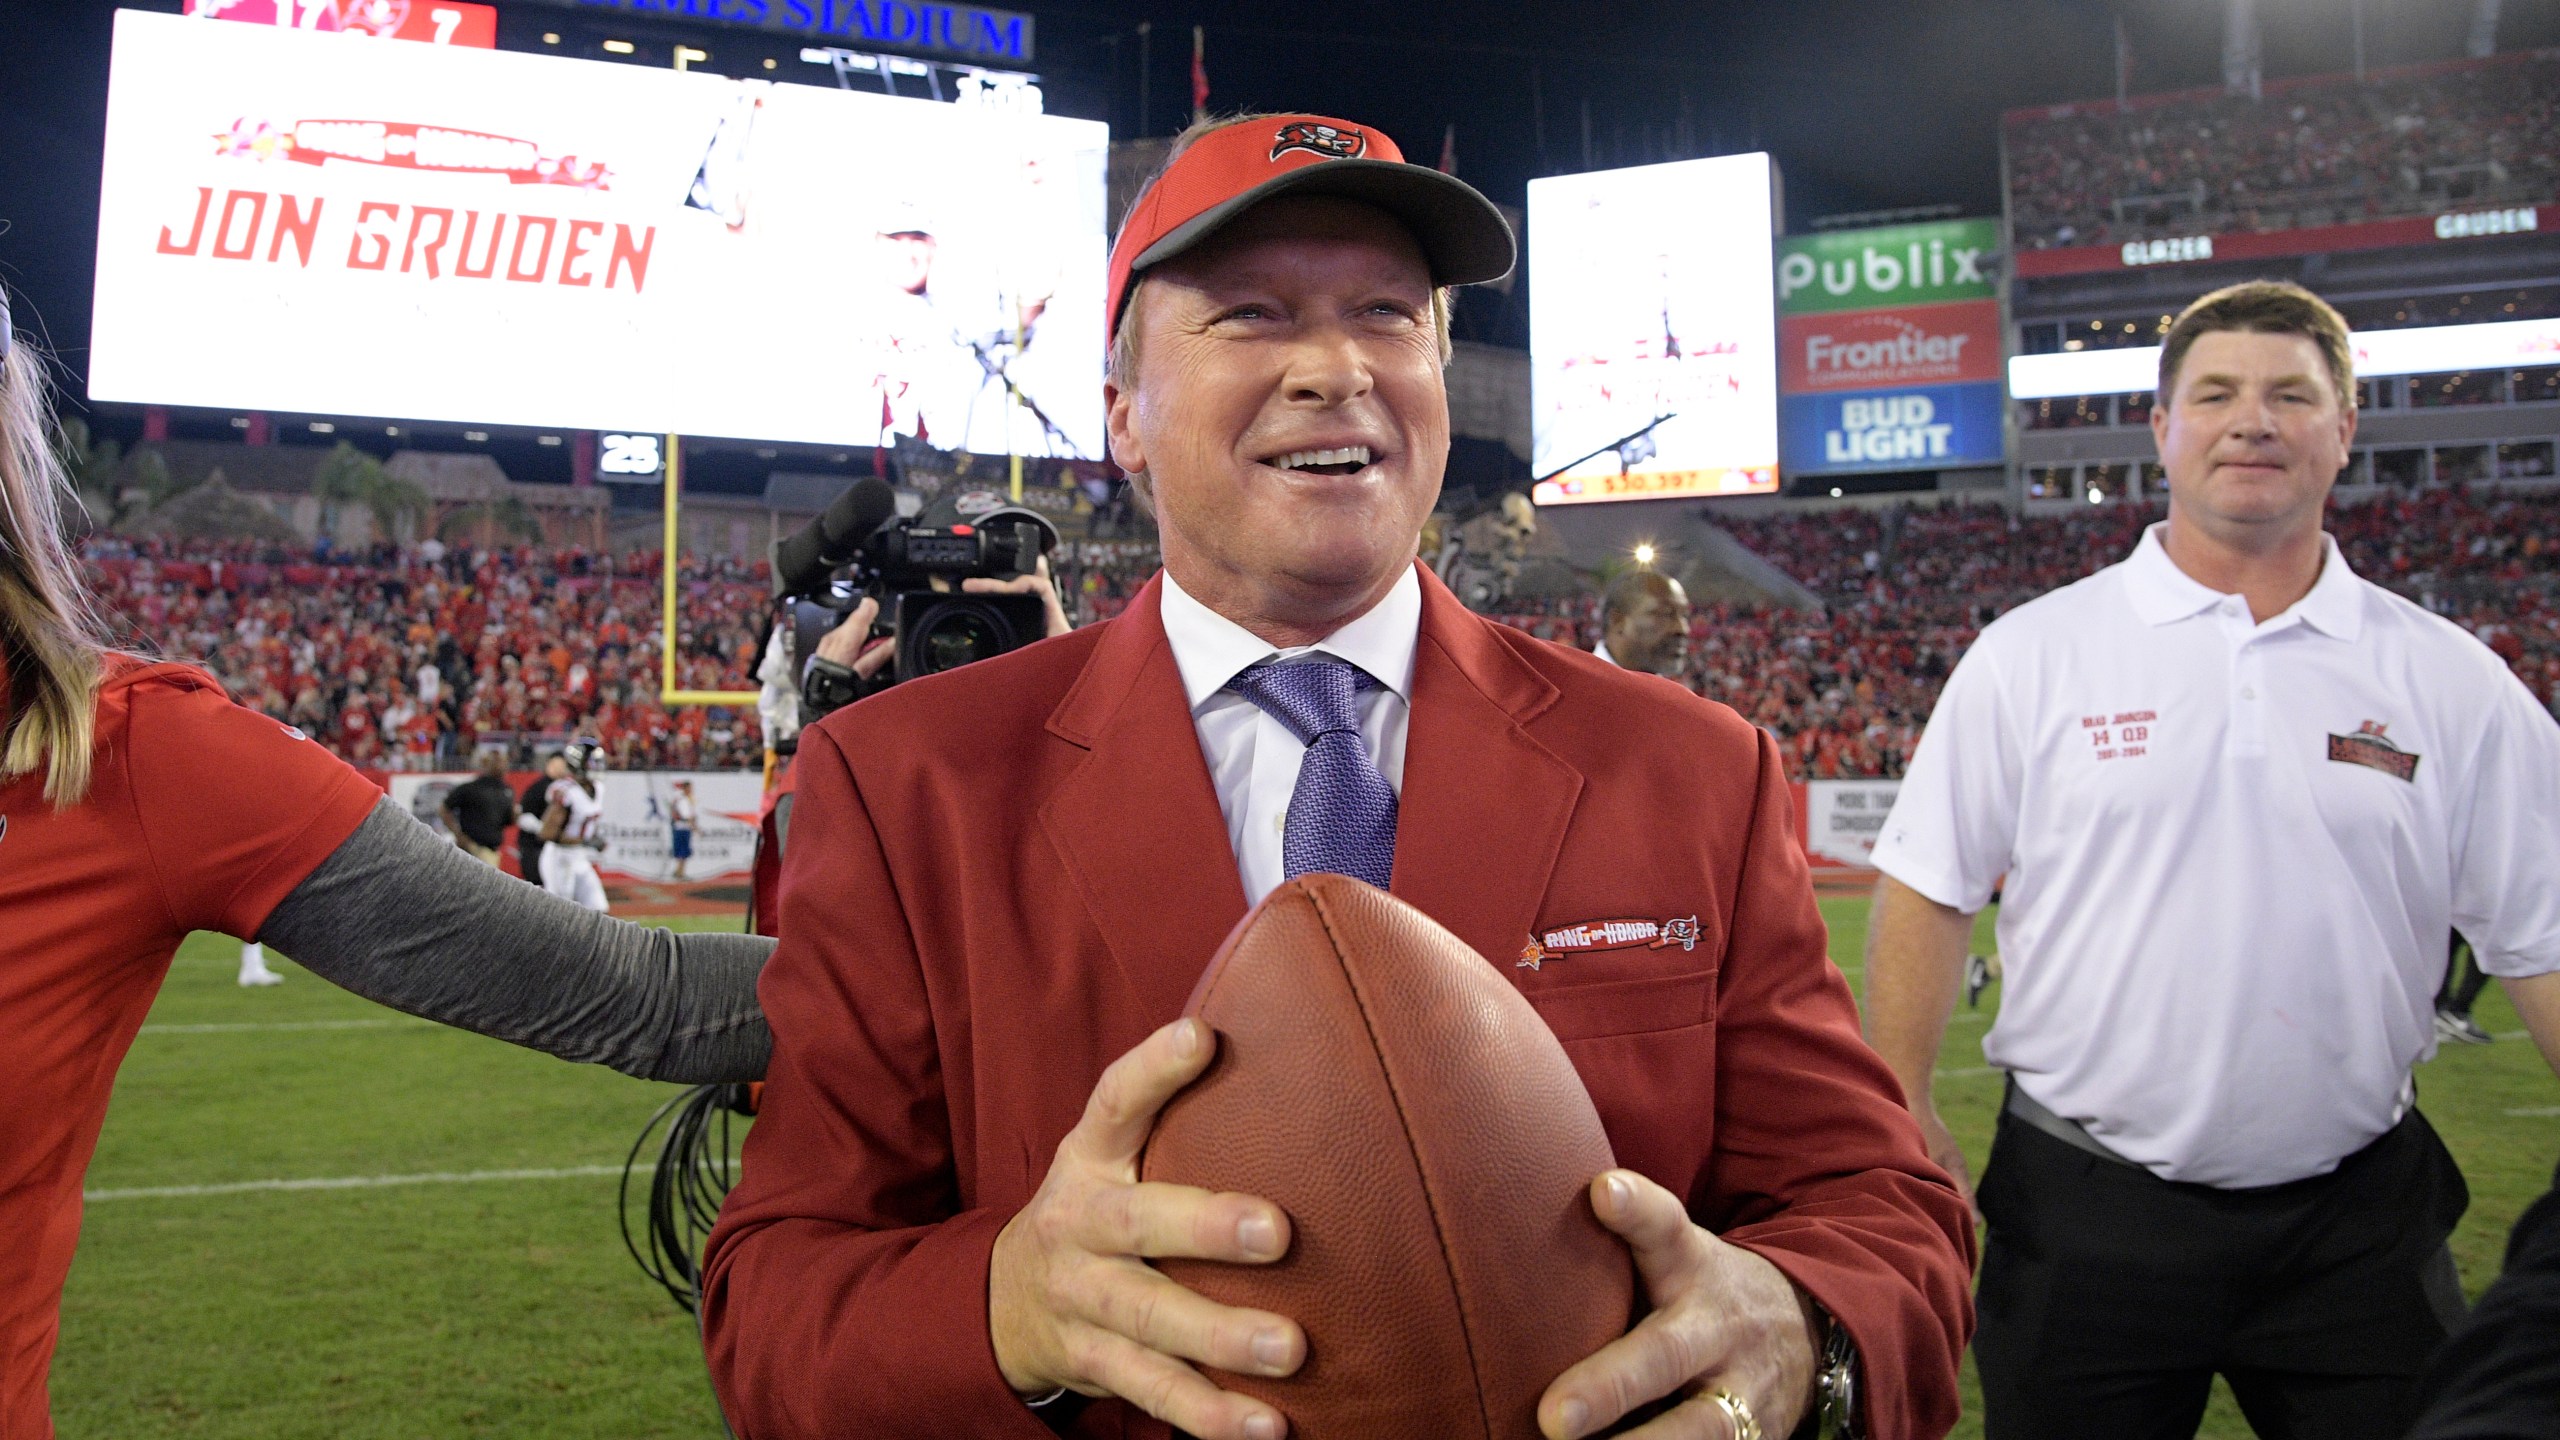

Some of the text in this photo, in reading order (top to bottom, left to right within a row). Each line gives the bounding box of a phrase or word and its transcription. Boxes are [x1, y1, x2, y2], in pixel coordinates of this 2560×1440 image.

[431, 9, 462, 45] 7
[783, 0, 1023, 58] STADIUM
[156, 186, 656, 294] JON GRUDEN
[2435, 207, 2538, 239] GRUDEN
[1779, 240, 1984, 299] Publix
[2121, 235, 2214, 266] GLAZER
[1806, 330, 1968, 371] Frontier
[1842, 395, 1935, 432] BUD
[601, 434, 659, 474] 25
[1825, 424, 1952, 463] LIGHT
[1545, 926, 1592, 948] RING
[1604, 922, 1659, 944] HONOR
